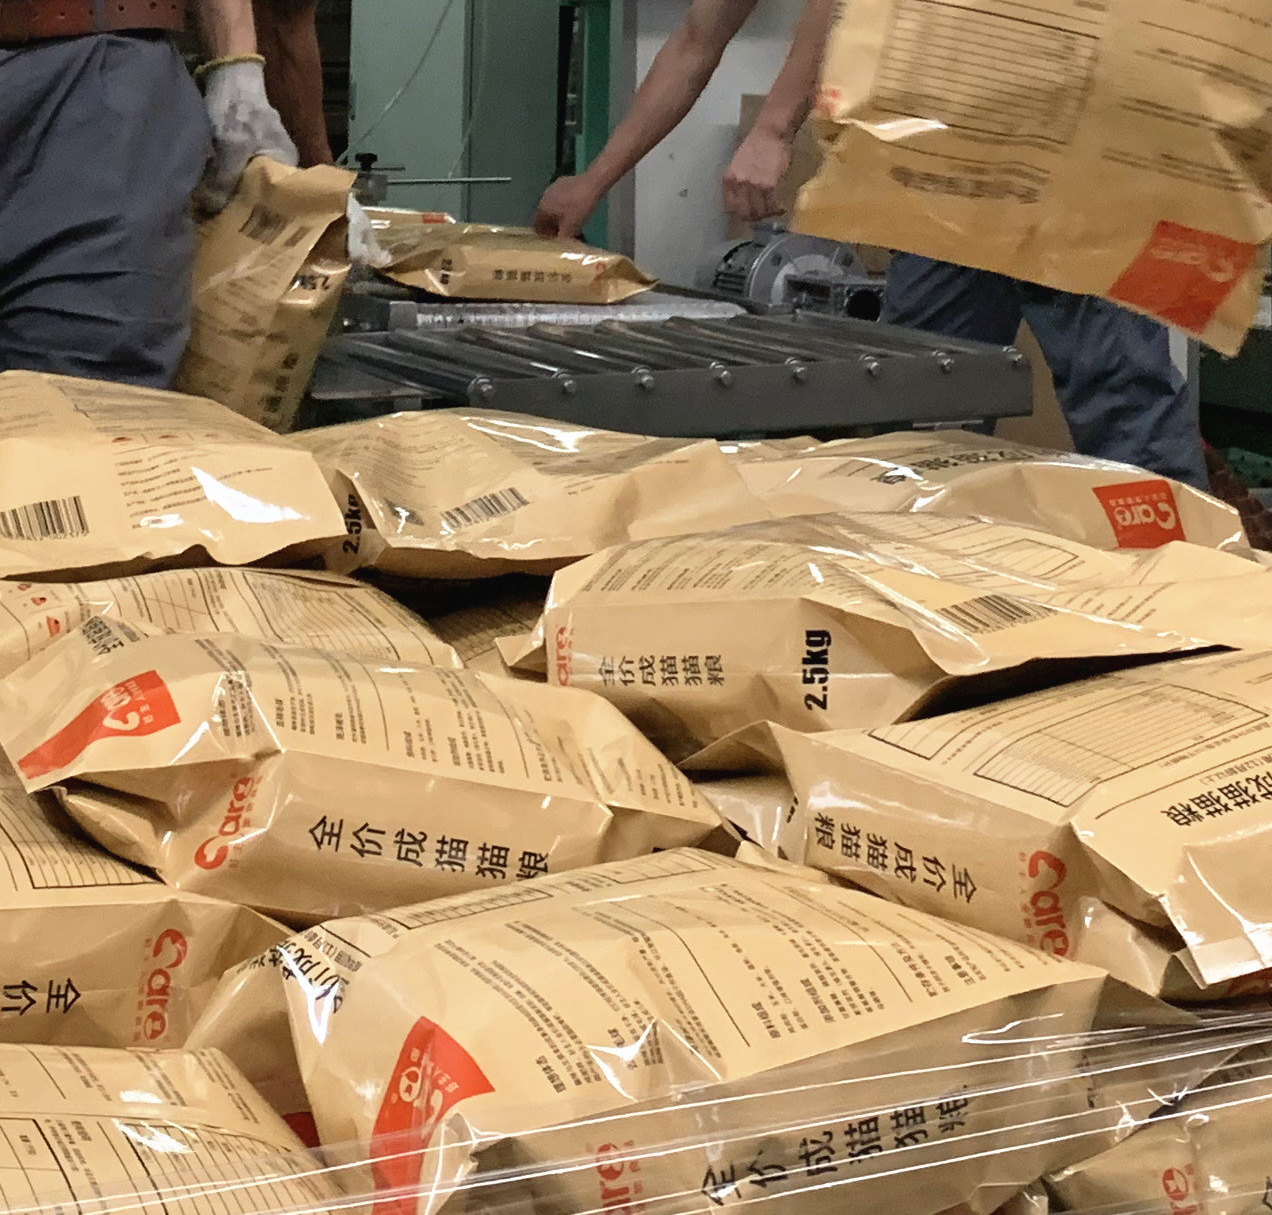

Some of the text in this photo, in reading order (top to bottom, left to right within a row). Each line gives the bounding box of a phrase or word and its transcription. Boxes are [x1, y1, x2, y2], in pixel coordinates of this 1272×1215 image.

[1114, 501, 1176, 531] Care
[598, 654, 726, 687] 全价成猫猫粮
[801, 629, 832, 711] 2.5kg
[193, 776, 256, 871] Care
[308, 815, 550, 882] 全价成猫猫粮
[813, 812, 978, 904] 全价成猫猫粮
[1028, 849, 1070, 957] Care
[142, 928, 189, 1041] Care
